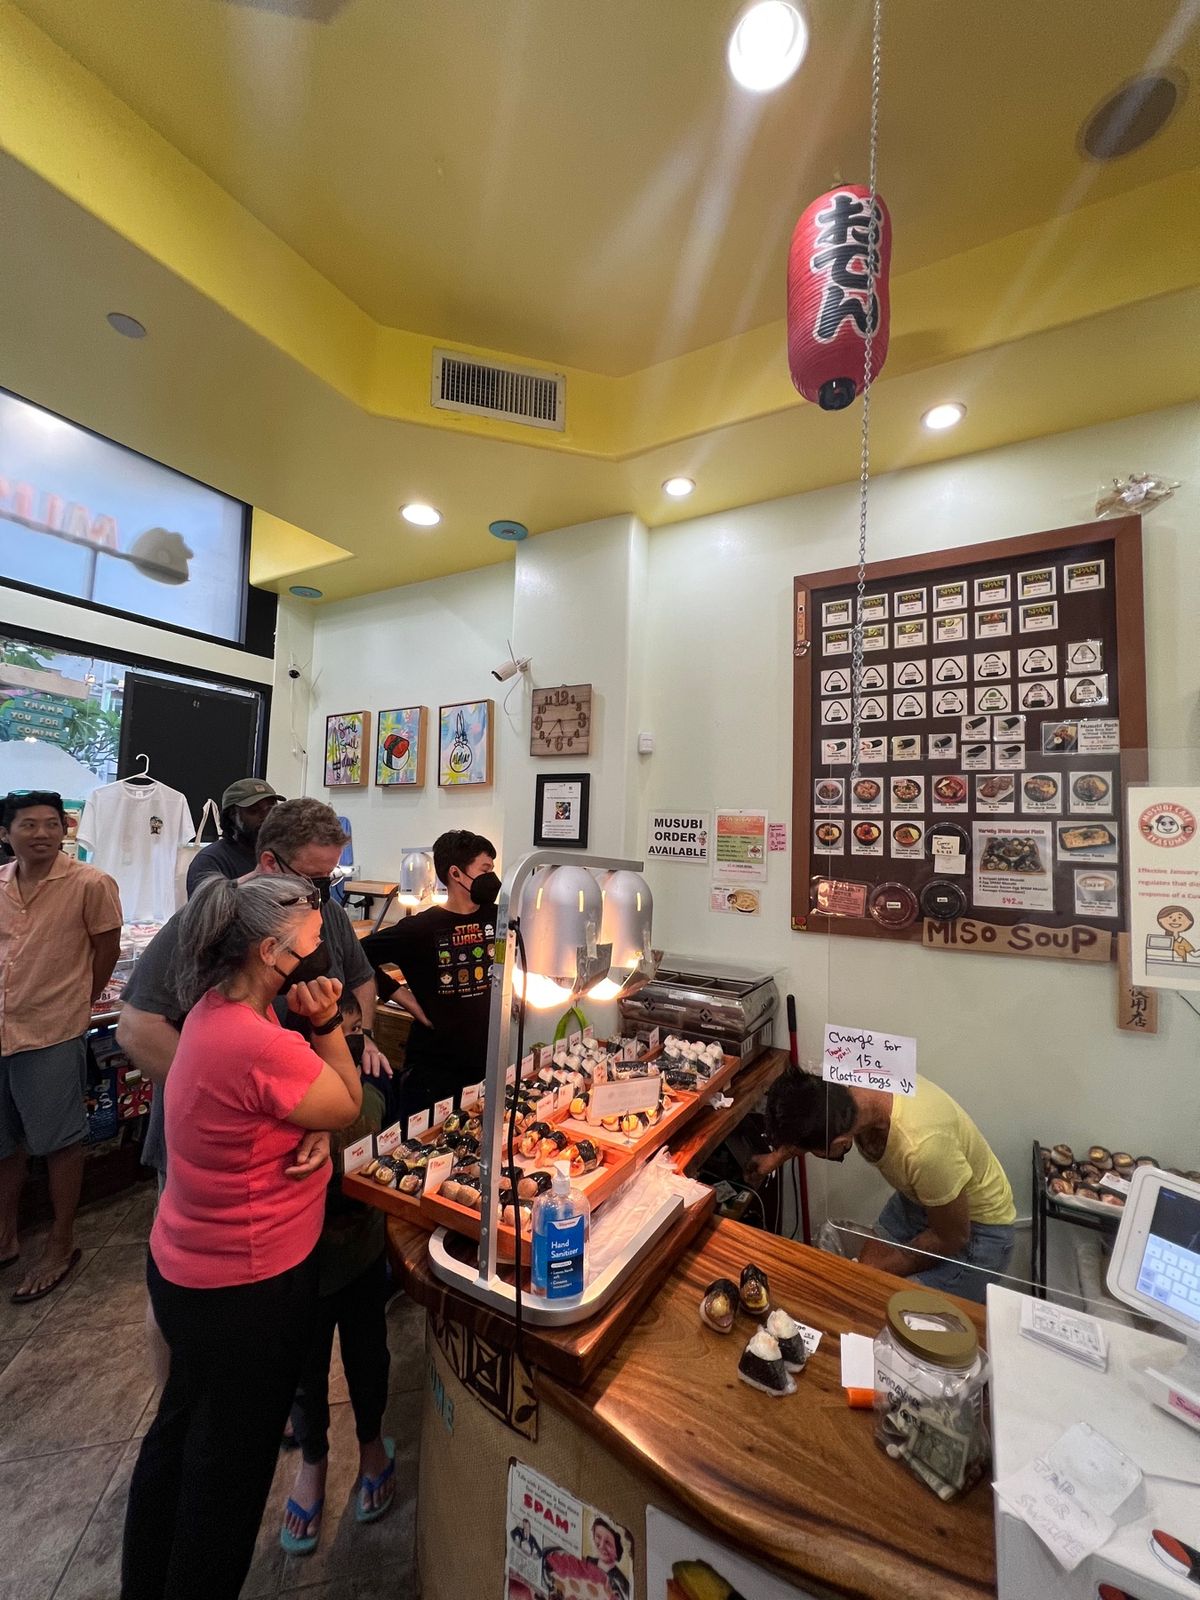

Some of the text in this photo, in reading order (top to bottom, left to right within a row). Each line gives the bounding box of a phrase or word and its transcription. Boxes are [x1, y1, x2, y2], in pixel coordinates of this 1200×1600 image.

[983, 580, 1004, 588] SPAM
[940, 586, 960, 595] SPAM
[544, 696, 552, 705] 11
[554, 690, 569, 706] 12
[570, 695, 575, 704] 1
[24, 701, 64, 714] THANK
[538, 705, 546, 714] 10
[11, 712, 59, 726] YOU FOR
[535, 715, 542, 730] 9
[578, 712, 586, 728] 3
[539, 731, 544, 740] 8
[546, 738, 551, 747] 7
[555, 736, 563, 751] 6
[654, 818, 702, 828] MUSUBI
[655, 832, 696, 842] ORDER
[648, 846, 706, 856] AVAILABLE
[452, 924, 482, 936] STAR
[452, 933, 483, 946] WARS
[828, 1032, 902, 1051] Charge for
[825, 1047, 842, 1056] Thank
[830, 1065, 890, 1089] Plastic bags
[551, 1240, 569, 1248] Hand
[551, 1248, 578, 1258] Sanitizer
[1033, 1457, 1075, 1496] TAP
[1044, 1494, 1070, 1520] OR
